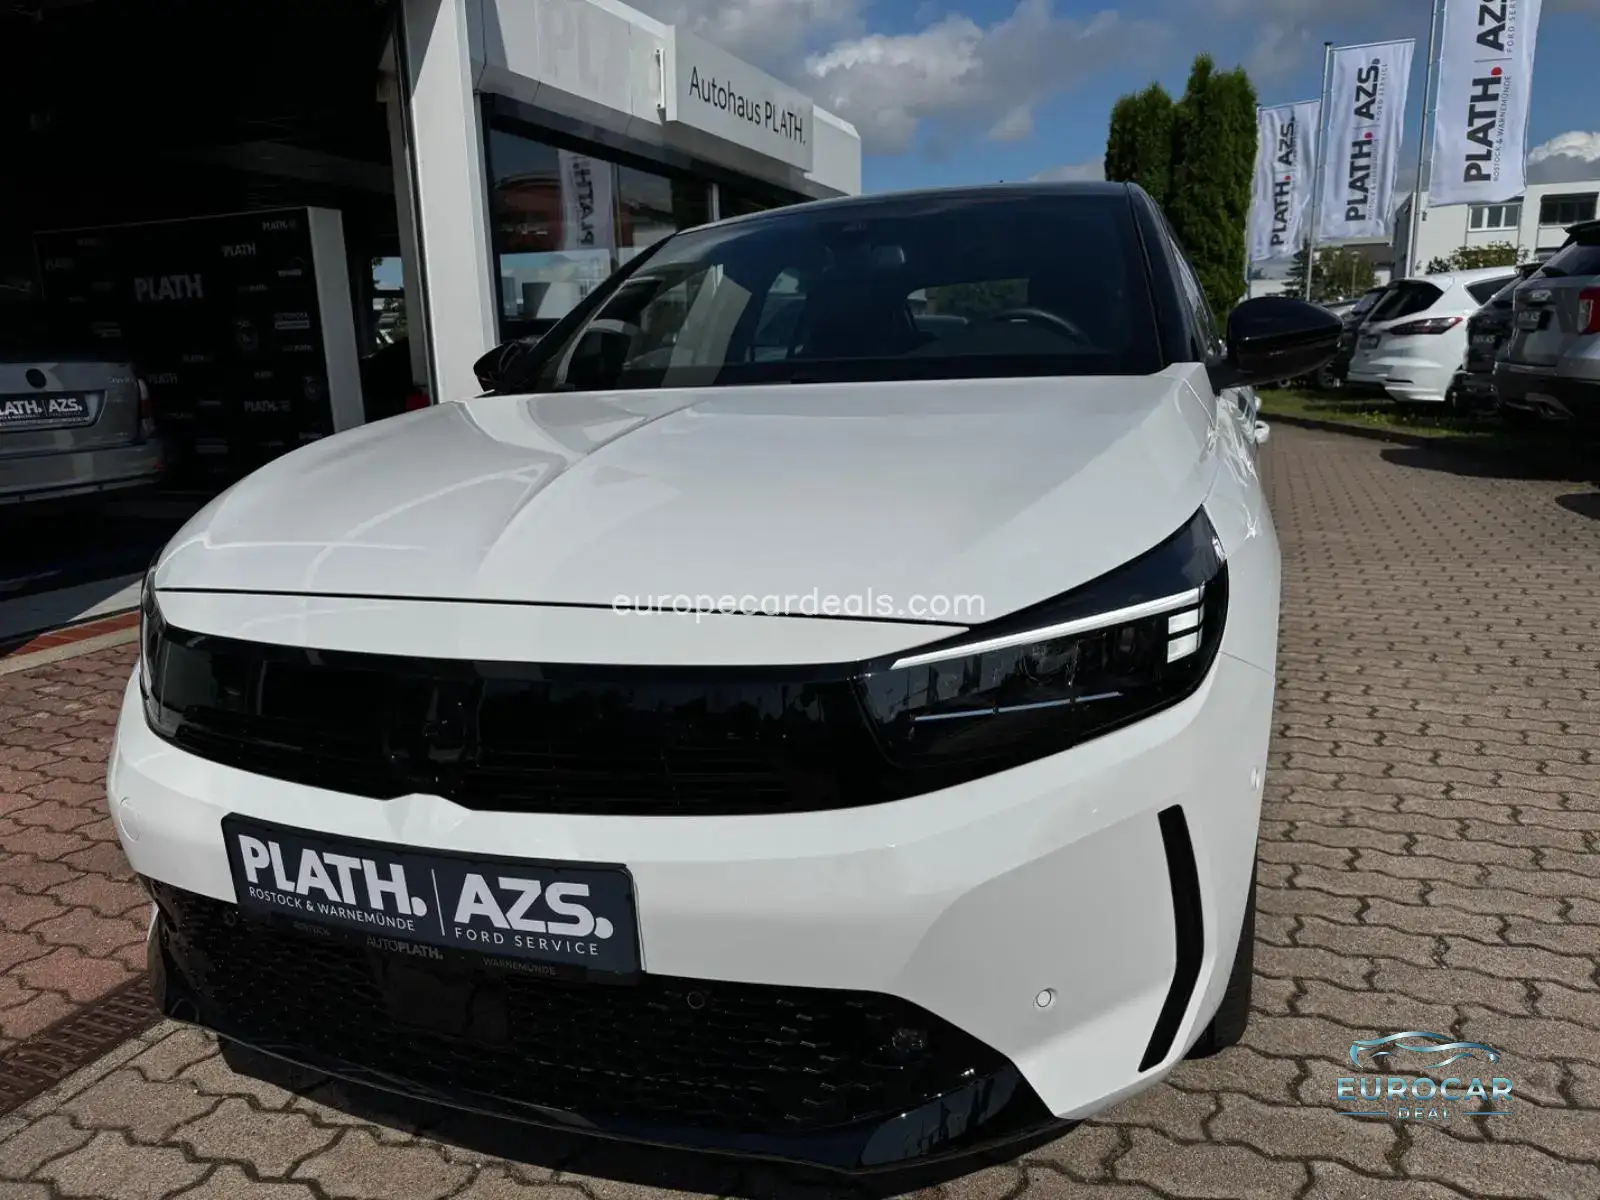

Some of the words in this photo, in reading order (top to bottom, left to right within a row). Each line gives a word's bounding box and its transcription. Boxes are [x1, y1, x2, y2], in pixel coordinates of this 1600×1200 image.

[1476, 0, 1507, 52] AZ
[1506, 27, 1515, 53] FORD
[689, 66, 761, 124] Autohaus
[765, 101, 806, 144] PLATH.
[1354, 58, 1380, 120] AZS.
[1277, 116, 1295, 166] AZS.
[1464, 67, 1502, 182] PLATH.
[1345, 131, 1373, 221] PLATH.
[1270, 175, 1291, 246] PLATH.
[49, 398, 83, 412] AZS.
[238, 834, 427, 917] PLATH.
[454, 873, 614, 939] AZS.
[248, 886, 302, 909] ROSTOCK
[306, 899, 315, 912] &
[317, 902, 416, 932] WARNEMÜNDE
[454, 927, 504, 945] FORD
[514, 935, 600, 956] SERVICE
